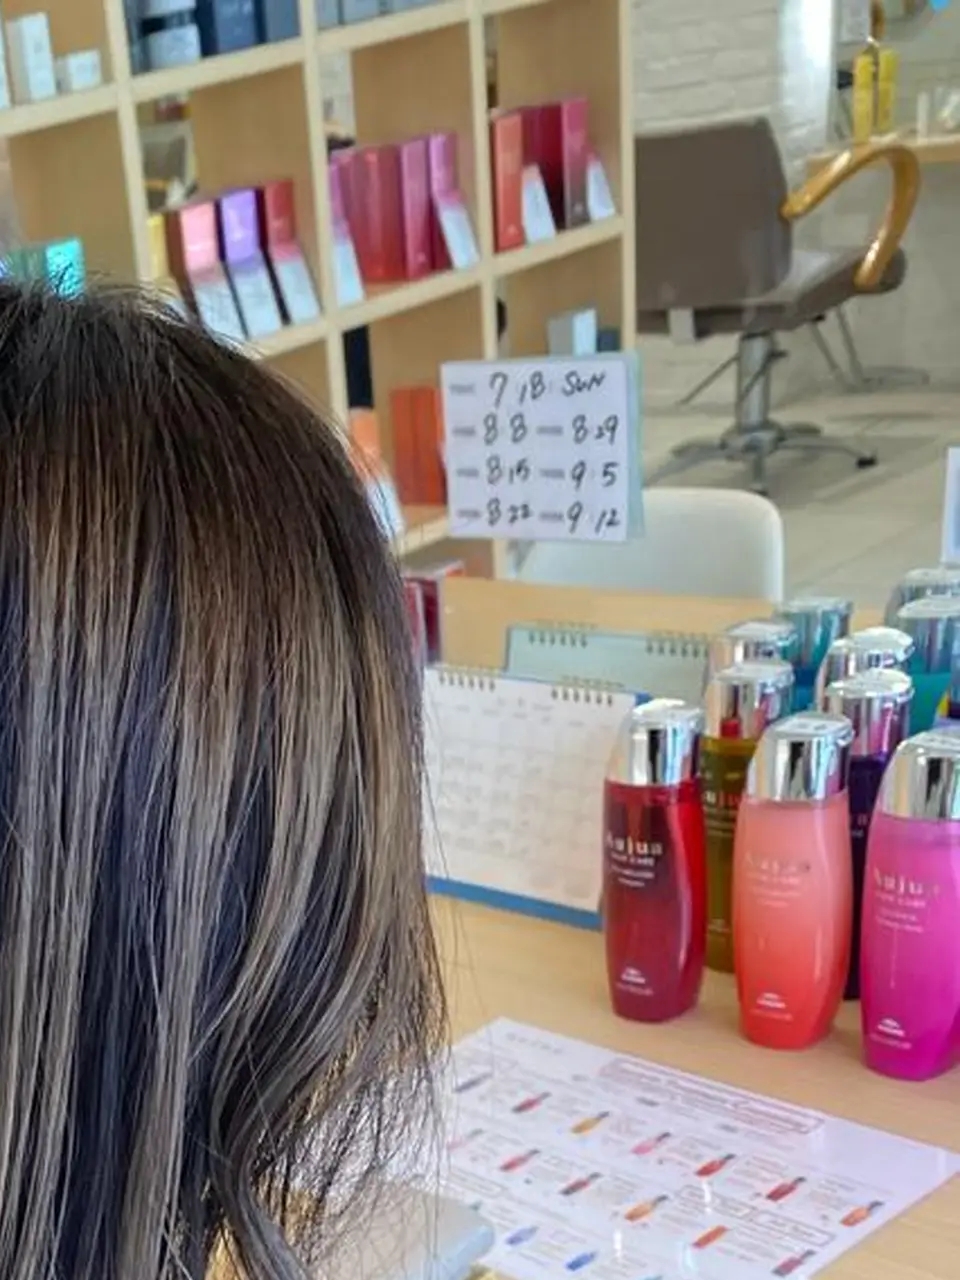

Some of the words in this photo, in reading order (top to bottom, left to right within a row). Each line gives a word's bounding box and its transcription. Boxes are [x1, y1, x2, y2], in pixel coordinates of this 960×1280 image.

[489, 371, 508, 409] 7
[483, 412, 498, 446] 8
[509, 412, 528, 444] 8
[572, 414, 588, 445] 8
[486, 453, 502, 486] 8
[571, 460, 586, 492] 9
[602, 461, 620, 487] 5
[486, 497, 501, 528] 8
[566, 500, 583, 535] 9
